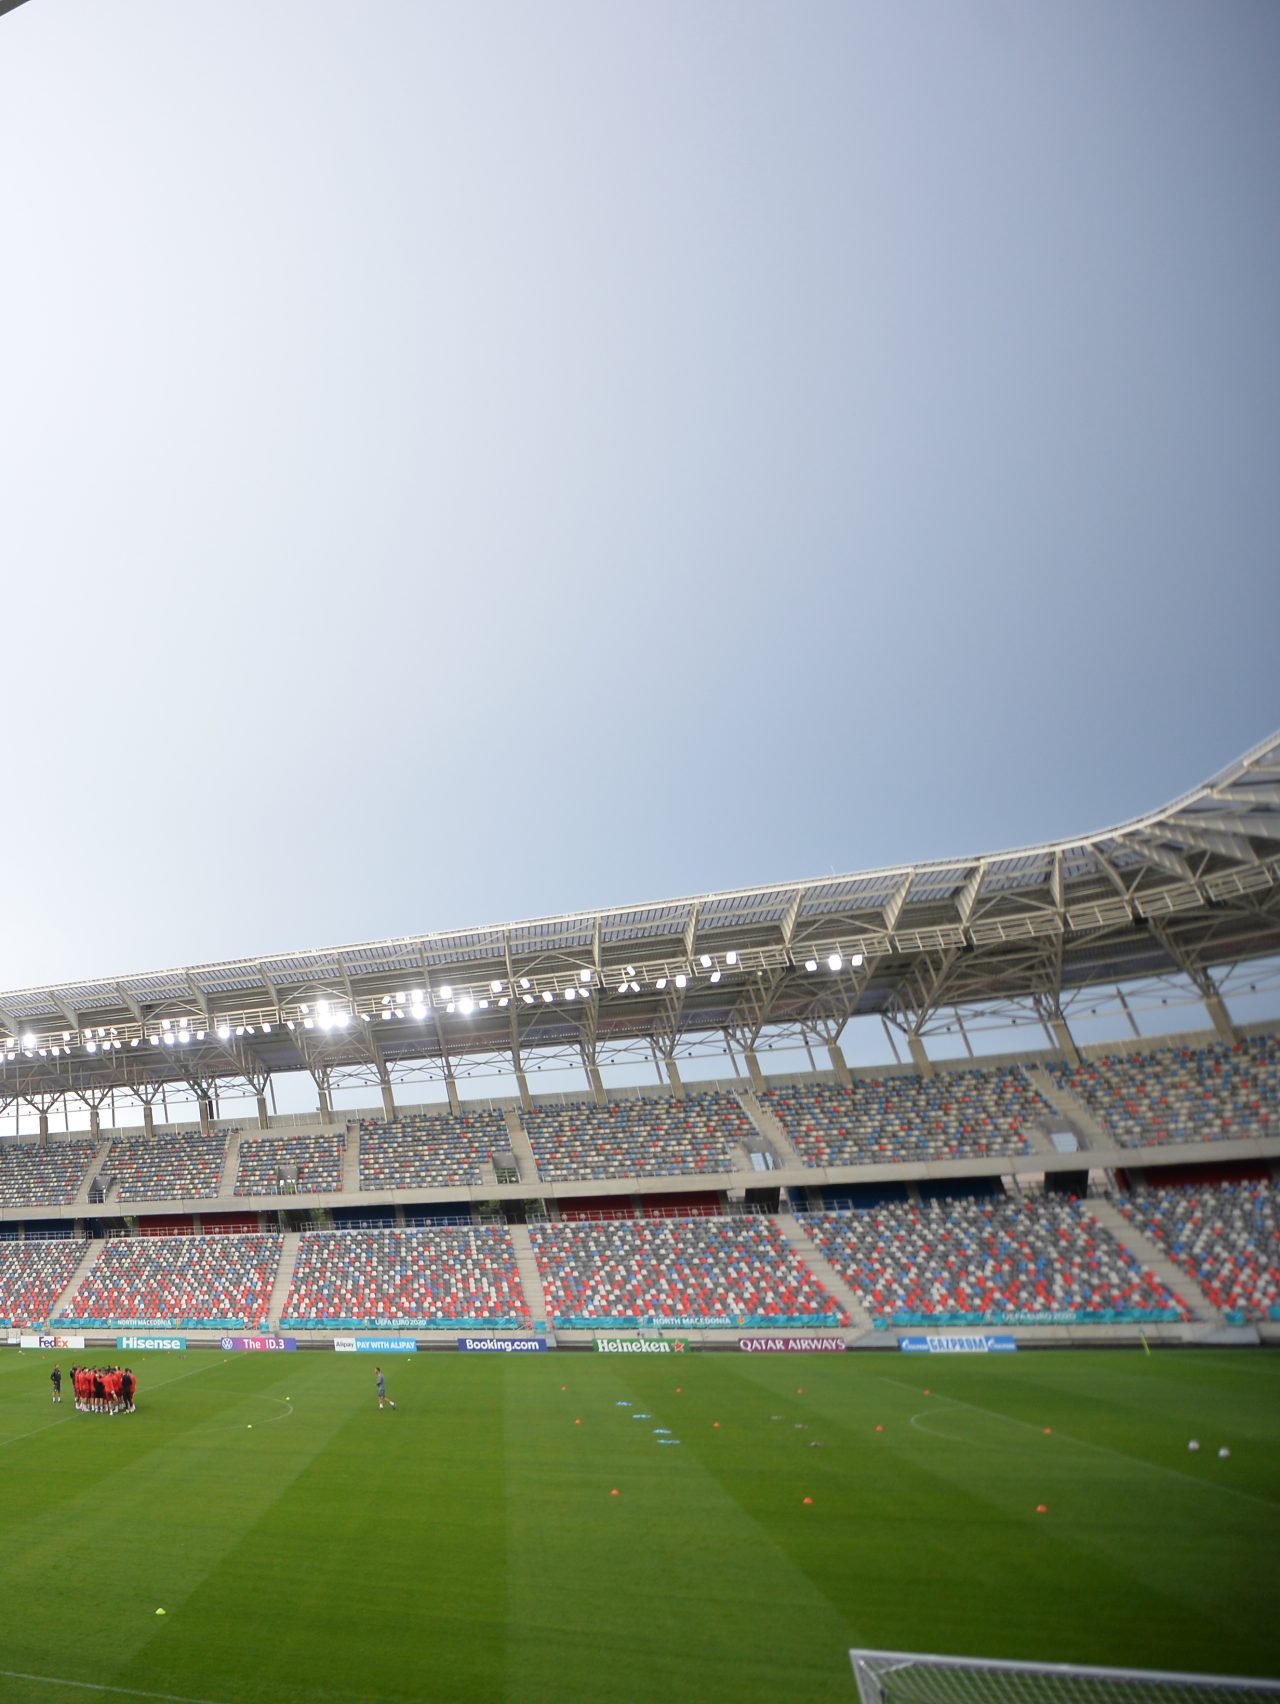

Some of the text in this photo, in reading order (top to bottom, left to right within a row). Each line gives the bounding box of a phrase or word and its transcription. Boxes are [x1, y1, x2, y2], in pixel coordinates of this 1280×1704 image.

[653, 1316, 731, 1325] NORTH MACEDONIA
[38, 1336, 68, 1348] FedEx
[122, 1337, 181, 1349] Hisense
[243, 1338, 285, 1349] The ID.3
[335, 1340, 354, 1349] Alipay
[356, 1340, 416, 1349] PAY WITH ALIPAY
[466, 1339, 539, 1351] Booking.com
[596, 1339, 670, 1353] Heineken
[739, 1337, 846, 1351] QATAR AIRWAYS
[929, 1337, 986, 1350] GAZPROM
